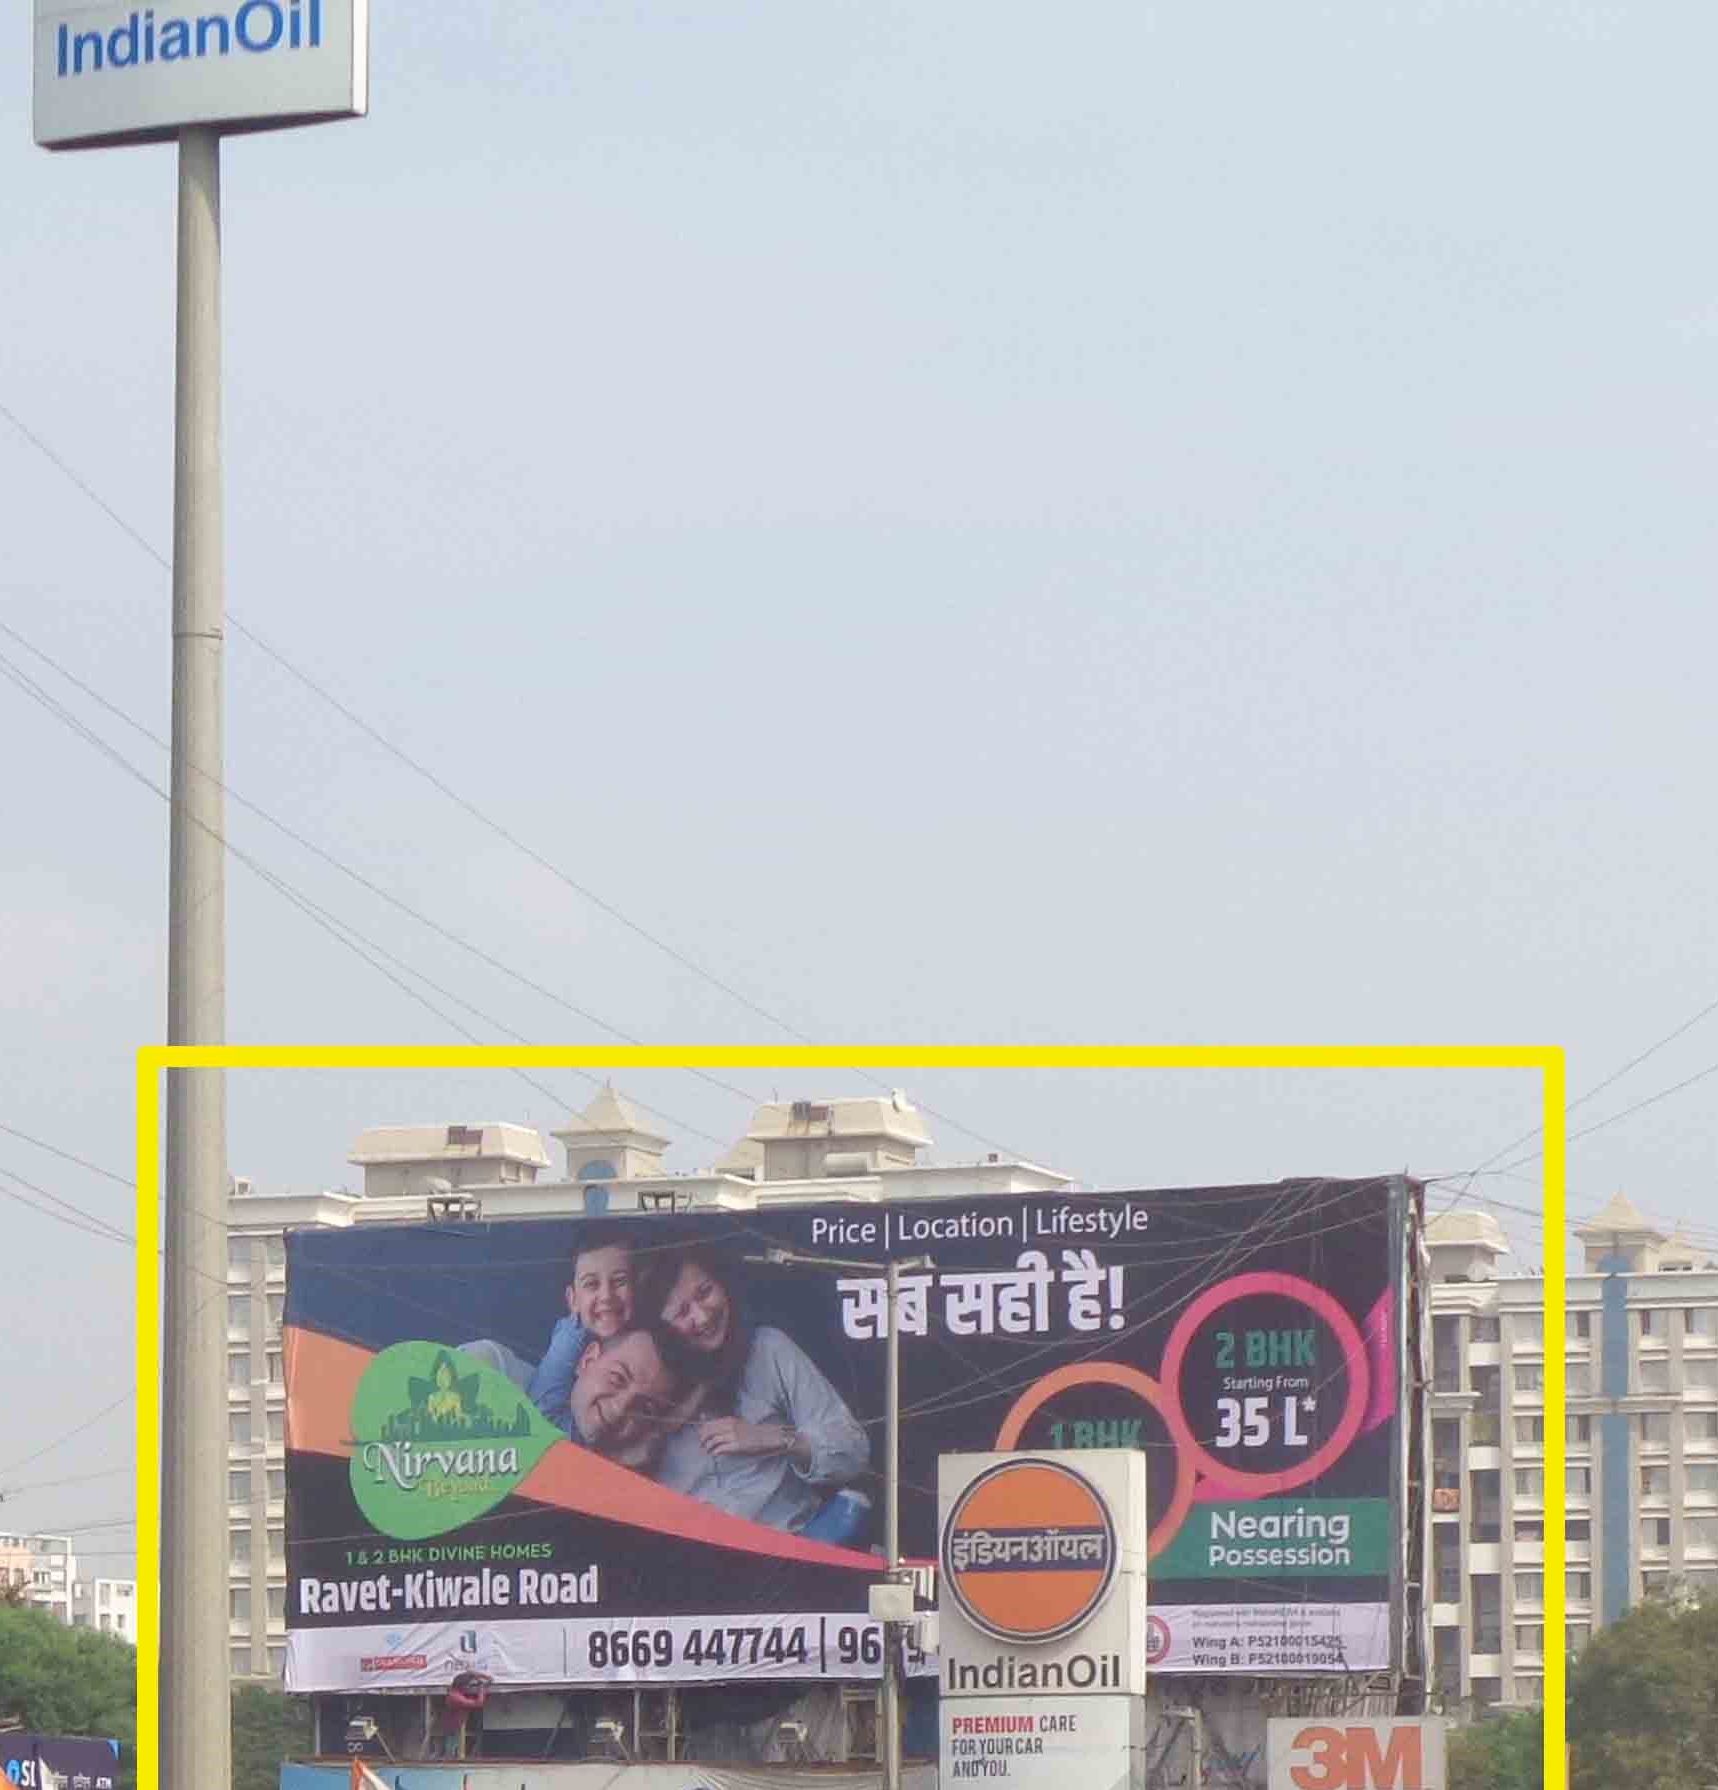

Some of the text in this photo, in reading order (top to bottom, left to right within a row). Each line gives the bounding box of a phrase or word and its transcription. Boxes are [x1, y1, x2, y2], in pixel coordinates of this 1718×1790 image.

[57, 0, 320, 78] IndianOil
[811, 1204, 1149, 1243] Price Location Lifestyle
[836, 1249, 1125, 1340] सब सही है!
[1214, 1328, 1317, 1369] 2 BHK
[1222, 1375, 1309, 1392] Starting From
[1215, 1397, 1271, 1448] 35
[364, 1440, 519, 1490] Nirvana
[1210, 1508, 1351, 1545] Nearing
[346, 1551, 354, 1566] 1
[373, 1550, 386, 1565] 2
[388, 1549, 425, 1564] BHK
[429, 1547, 485, 1562] DIVINE
[491, 1544, 553, 1560] HOMES
[952, 1529, 1105, 1570] इंडियनऑयल
[1209, 1543, 1351, 1567] Possession
[299, 1564, 599, 1614] Ravet-Kiwale Road
[589, 1629, 673, 1668] 8669
[682, 1626, 807, 1666] 447744
[1192, 1637, 1226, 1651] Wing
[1229, 1637, 1245, 1648] A:
[1192, 1654, 1226, 1667] Wing
[1229, 1653, 1245, 1664] B:
[948, 1654, 1120, 1690] IndianOil
[952, 1714, 1077, 1734] PREMIUM CARE
[952, 1737, 1043, 1756] FOR YOUR CAR
[95, 1776, 113, 1790] ATM
[952, 1760, 979, 1777] AND
